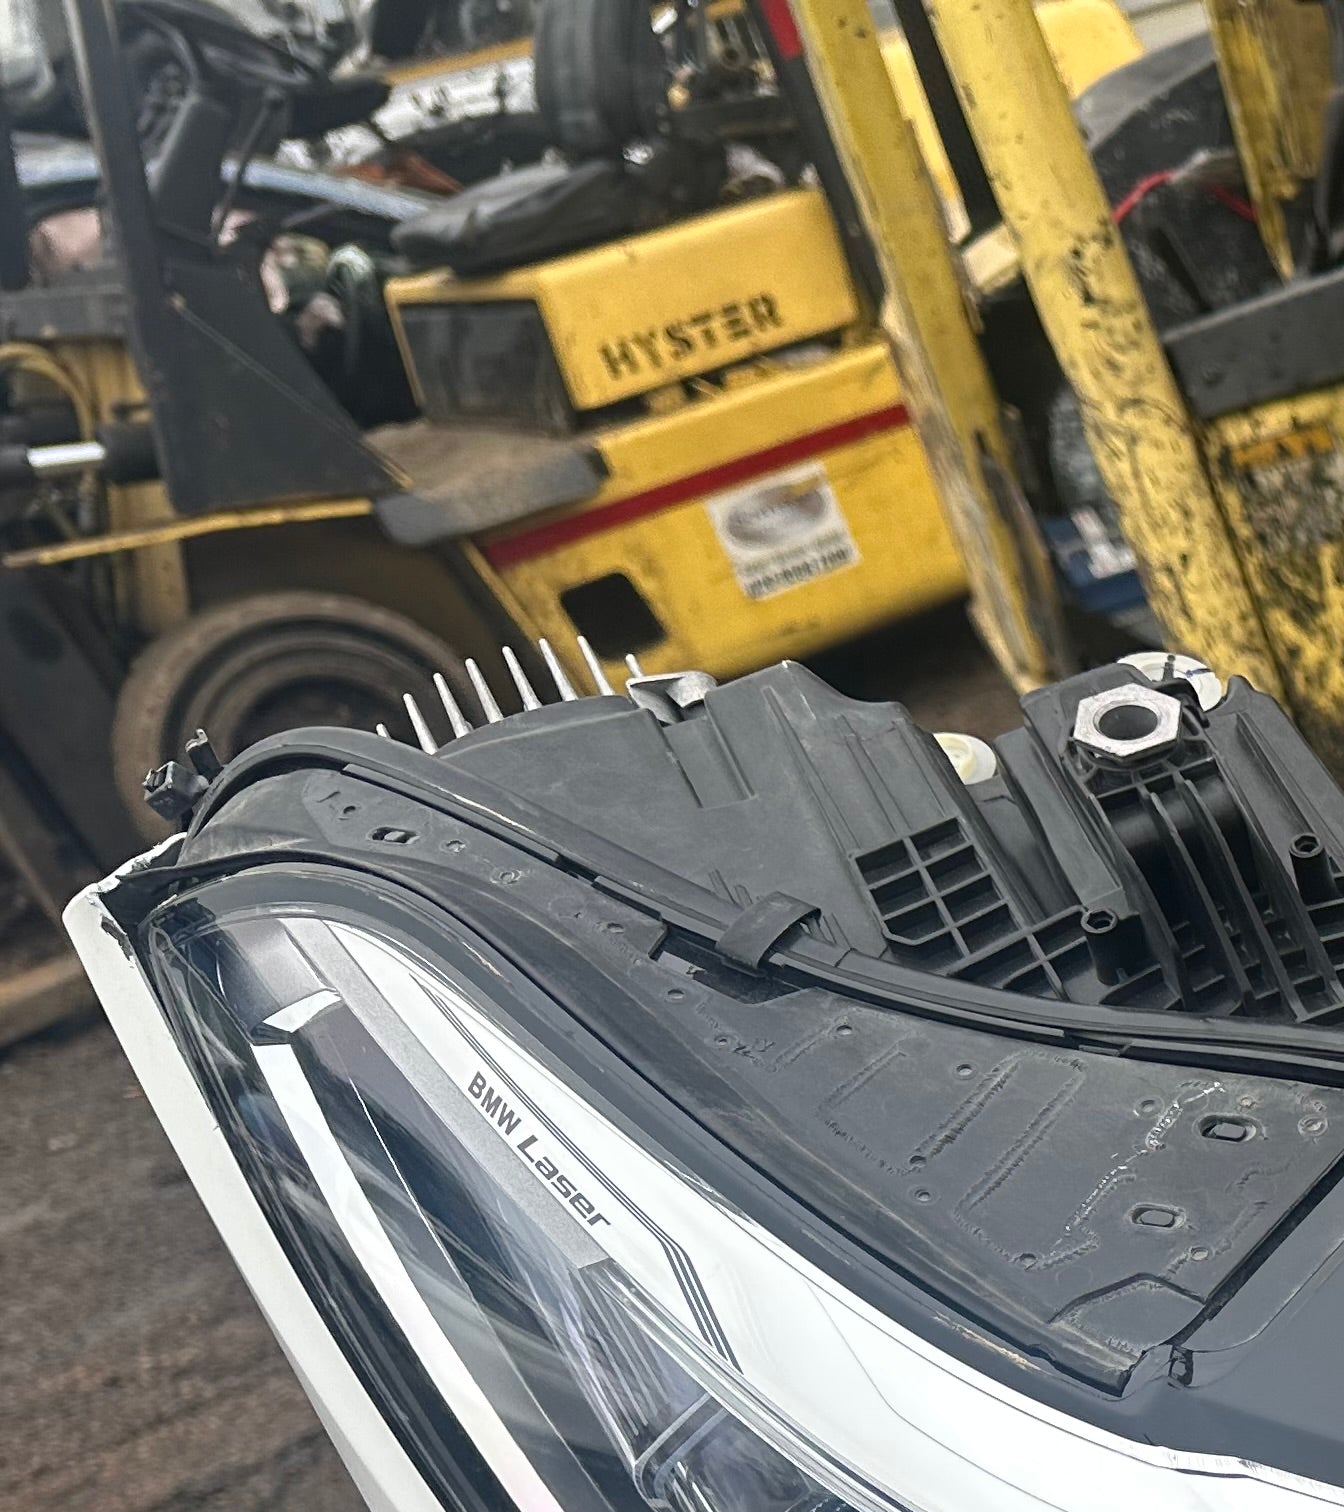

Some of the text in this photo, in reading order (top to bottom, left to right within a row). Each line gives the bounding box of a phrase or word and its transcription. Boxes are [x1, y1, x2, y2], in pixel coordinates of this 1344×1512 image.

[597, 290, 785, 380] HYSTER
[467, 1071, 611, 1226] BMW Laser
